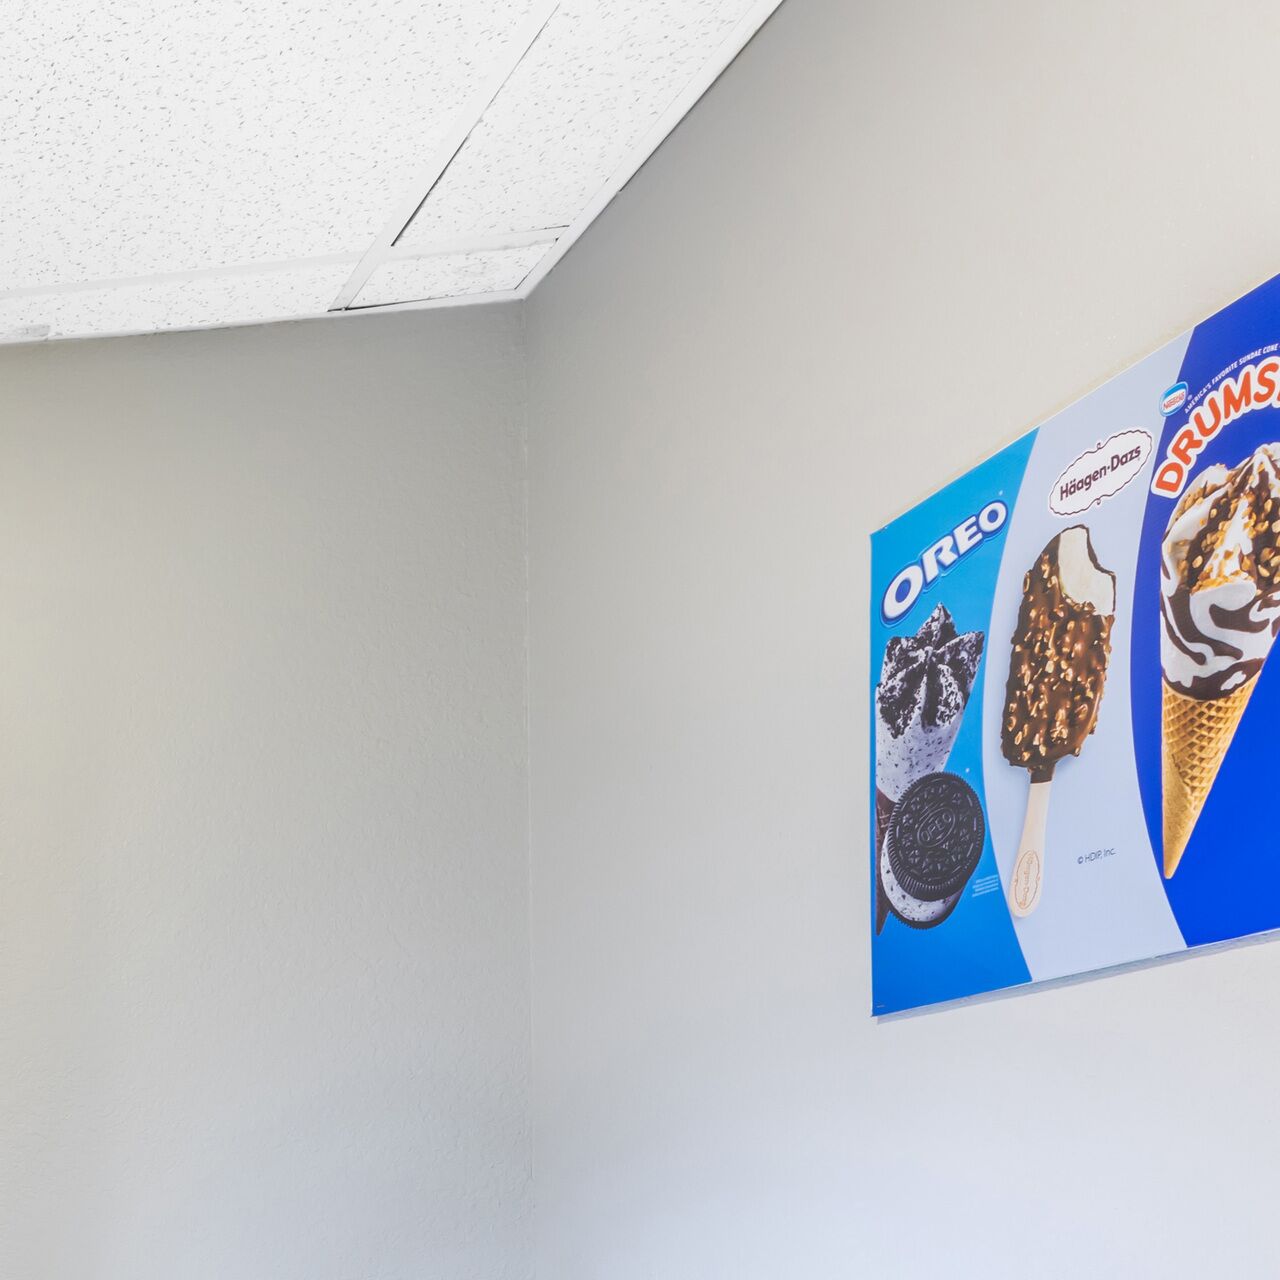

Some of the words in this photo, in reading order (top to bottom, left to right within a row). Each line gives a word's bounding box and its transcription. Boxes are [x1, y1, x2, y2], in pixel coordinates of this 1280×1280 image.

[1153, 359, 1280, 496] DRUMS
[1184, 383, 1213, 414] AMERICA'S
[1211, 361, 1238, 385] FAVORITE
[1239, 348, 1262, 365] SUNDAE
[1262, 343, 1280, 354] CONE
[881, 499, 1009, 625] OREO
[1084, 850, 1103, 864] HDIP,
